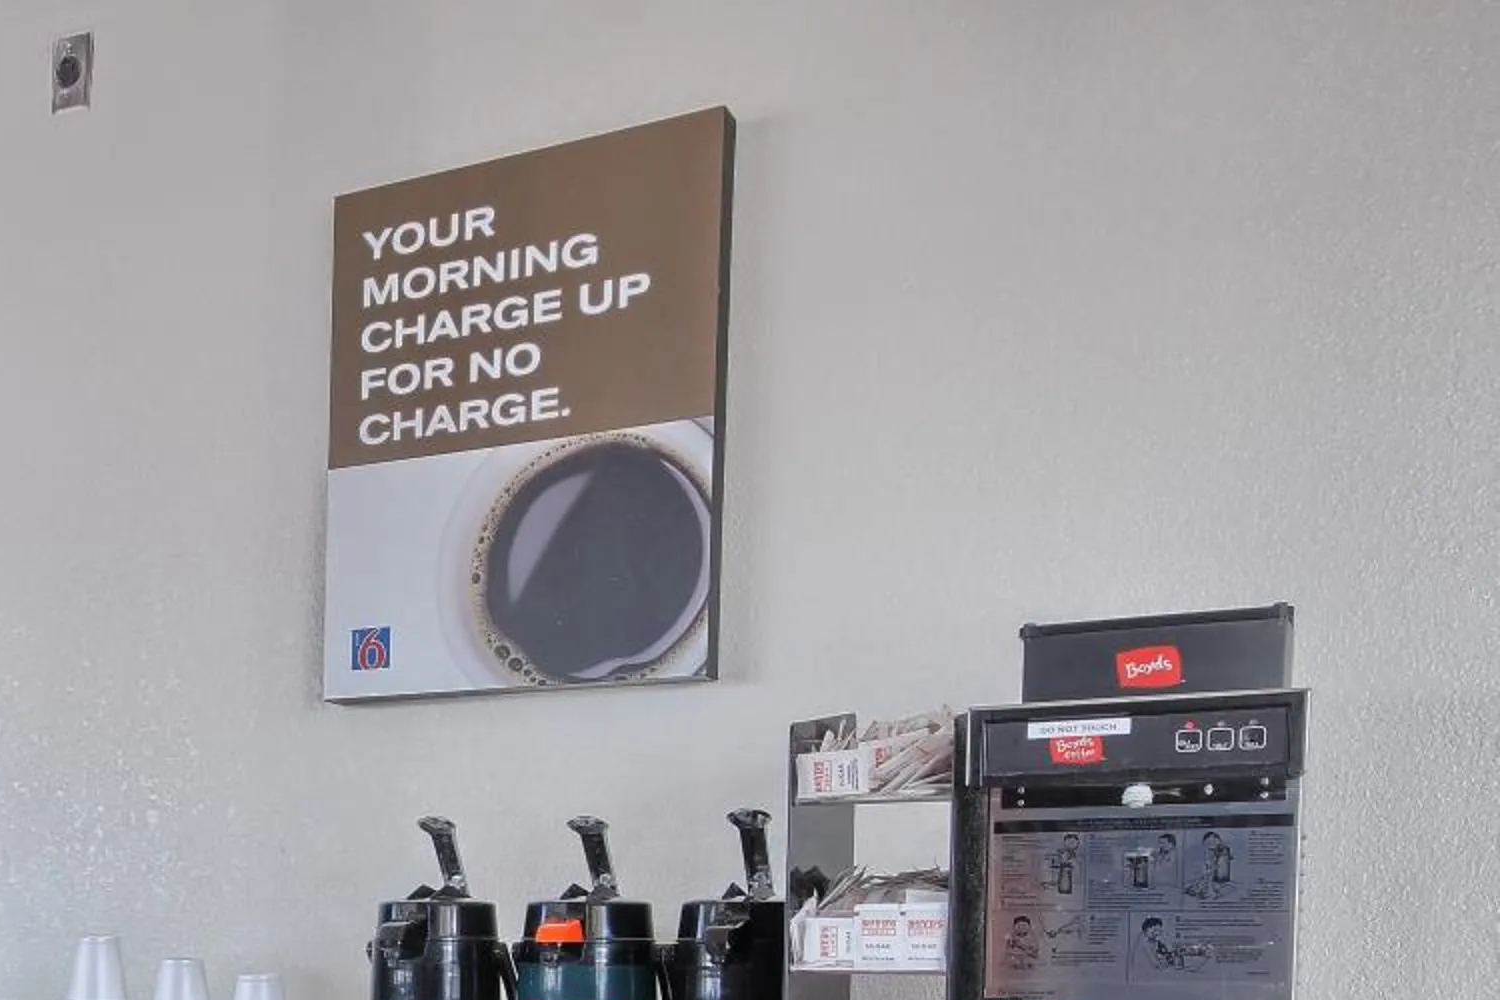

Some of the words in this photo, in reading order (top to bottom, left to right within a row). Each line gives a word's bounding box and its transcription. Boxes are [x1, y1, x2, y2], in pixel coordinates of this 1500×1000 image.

[362, 206, 495, 260] YOUR
[362, 233, 599, 307] MORNING
[361, 291, 563, 353] CHARGE
[579, 273, 651, 316] UP
[360, 357, 453, 399] FOR
[469, 342, 541, 384] NO
[359, 387, 571, 446] CHARGE.
